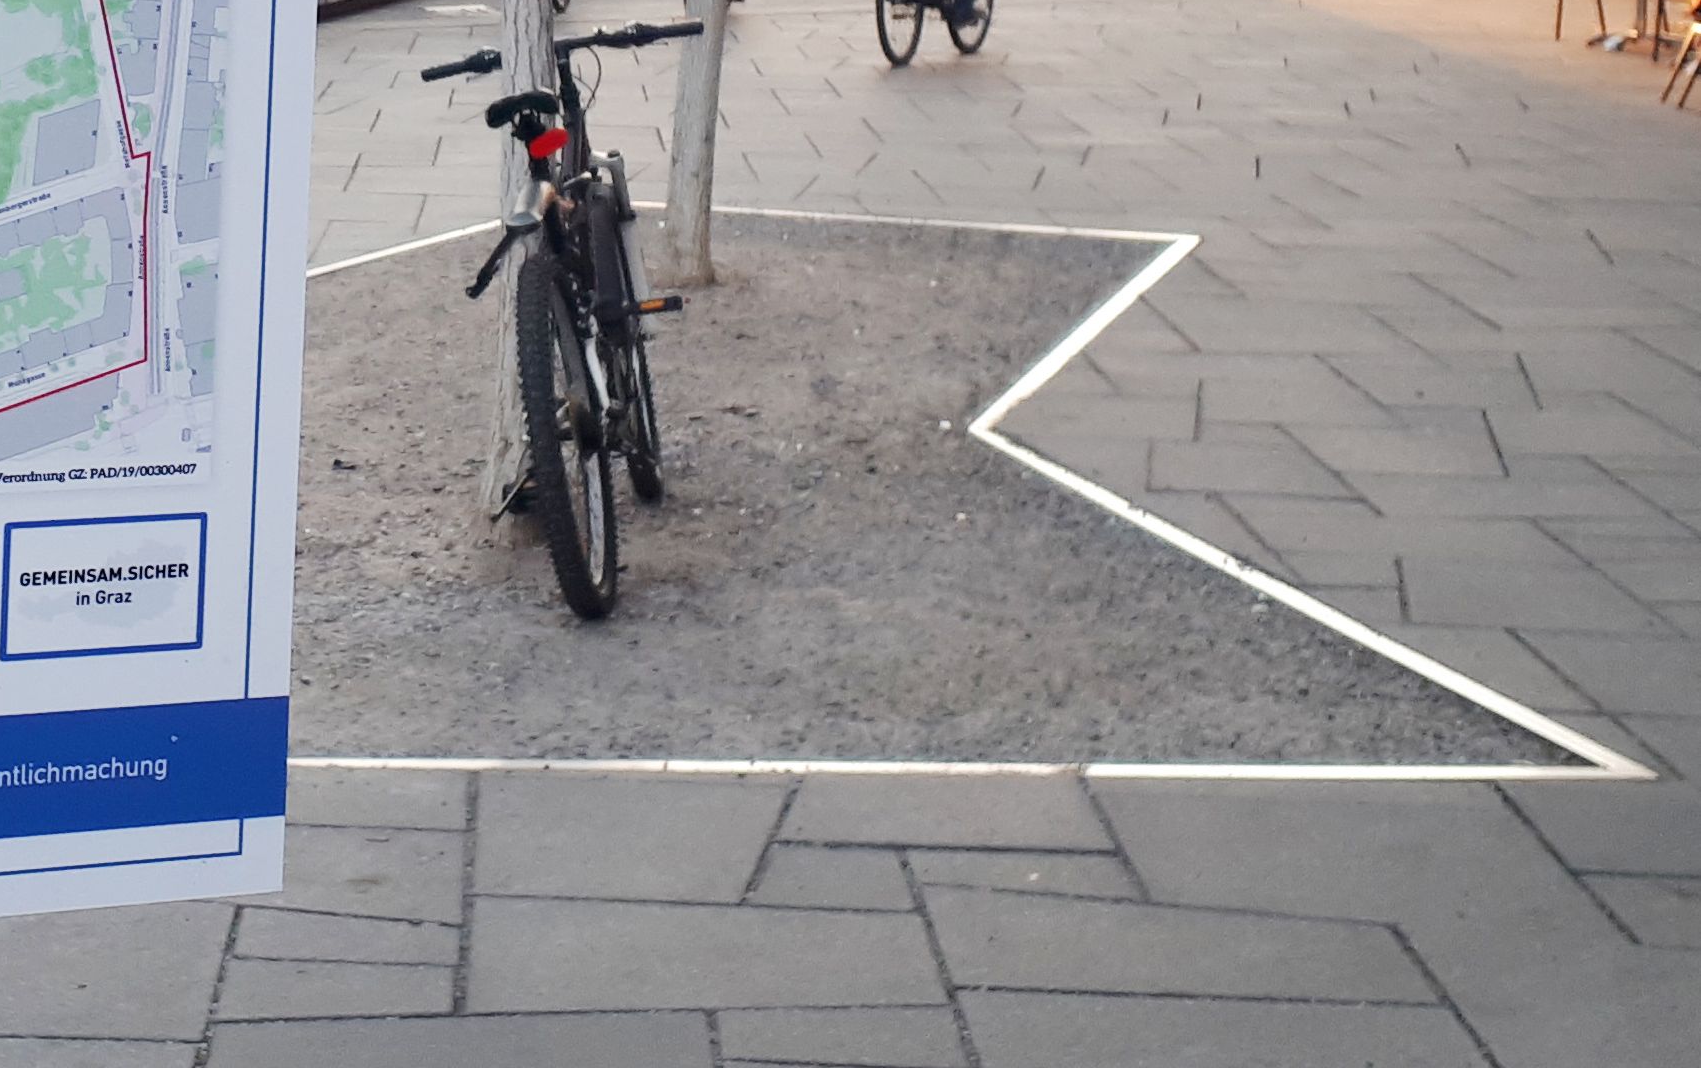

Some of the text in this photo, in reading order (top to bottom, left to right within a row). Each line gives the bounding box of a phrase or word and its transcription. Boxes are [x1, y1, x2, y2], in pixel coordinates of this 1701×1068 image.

[90, 463, 197, 479] PAD/19/00300407
[20, 563, 189, 587] GEMEINSAM.SICHER
[76, 590, 132, 606] in Graz
